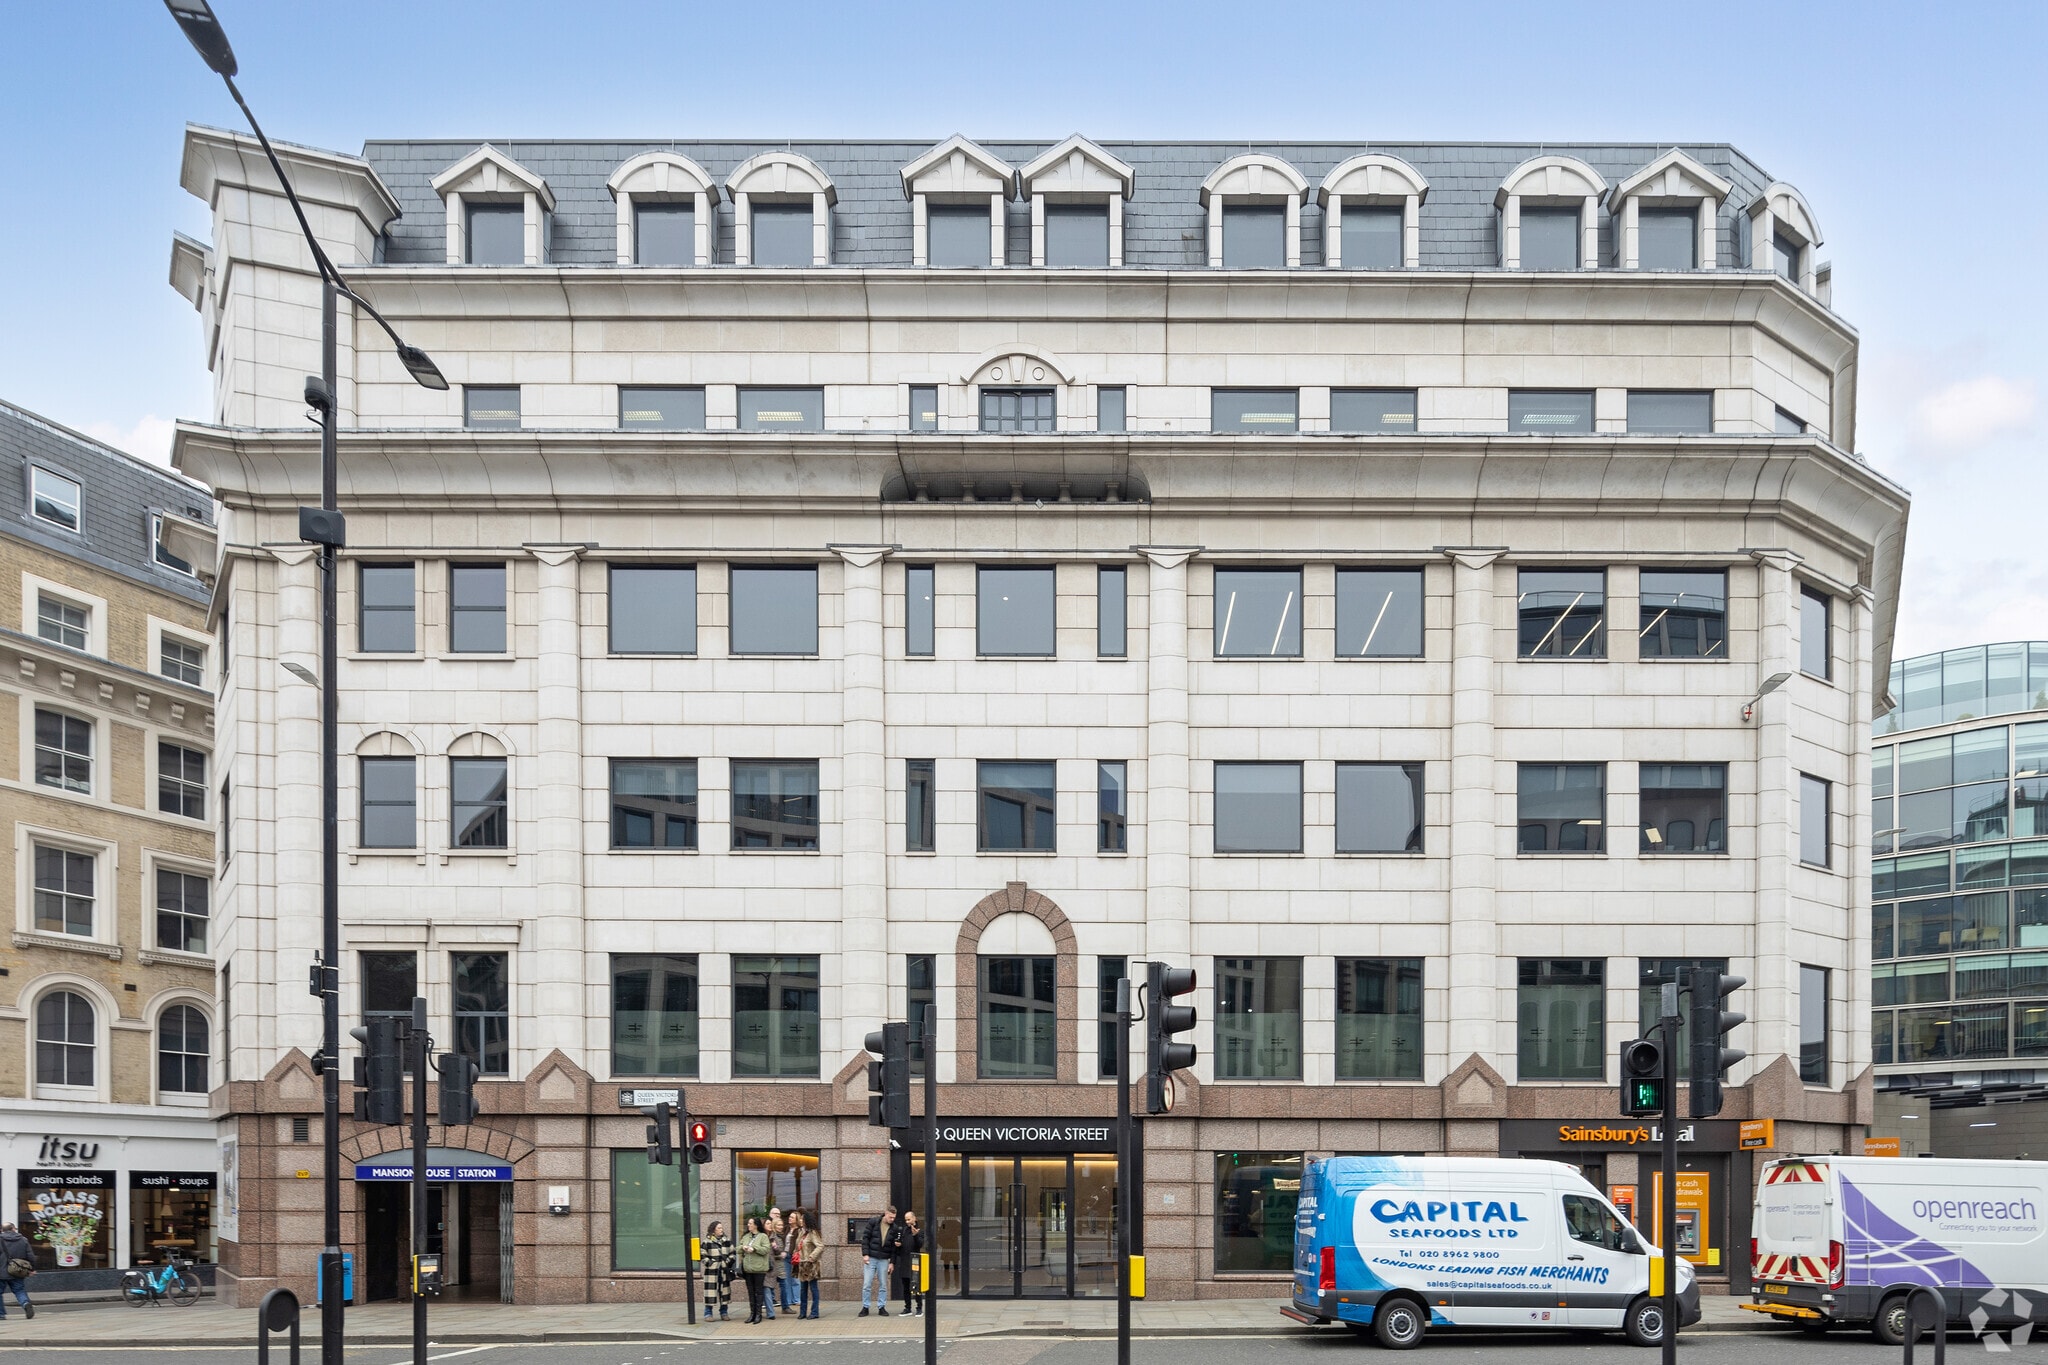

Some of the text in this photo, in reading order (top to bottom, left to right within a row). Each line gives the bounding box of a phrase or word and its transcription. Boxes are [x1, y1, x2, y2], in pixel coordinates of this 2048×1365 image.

[944, 1128, 991, 1141] QUEEN
[995, 1128, 1062, 1141] VICTORIA
[1064, 1128, 1109, 1141] STREET
[1559, 1126, 1694, 1145] Sainsbury's Lal
[39, 1135, 99, 1160] itsu
[32, 1176, 103, 1184] asian salads
[373, 1169, 496, 1177] MANSION OUSE STATION
[142, 1176, 209, 1186] sushi soups
[36, 1190, 99, 1205] GLASS
[32, 1205, 103, 1220] NOODLES
[1370, 1199, 1529, 1223] CAPITAL
[1913, 1198, 2036, 1222] openreach
[1389, 1228, 1518, 1238] SEAFOODS LTD
[1939, 1222, 1974, 1232] Connecting
[1372, 1257, 1609, 1285] LONDONS LEADING FISH MERCHANTS
[1426, 1280, 1552, 1290] sales@capitalseafoods.co.uk
